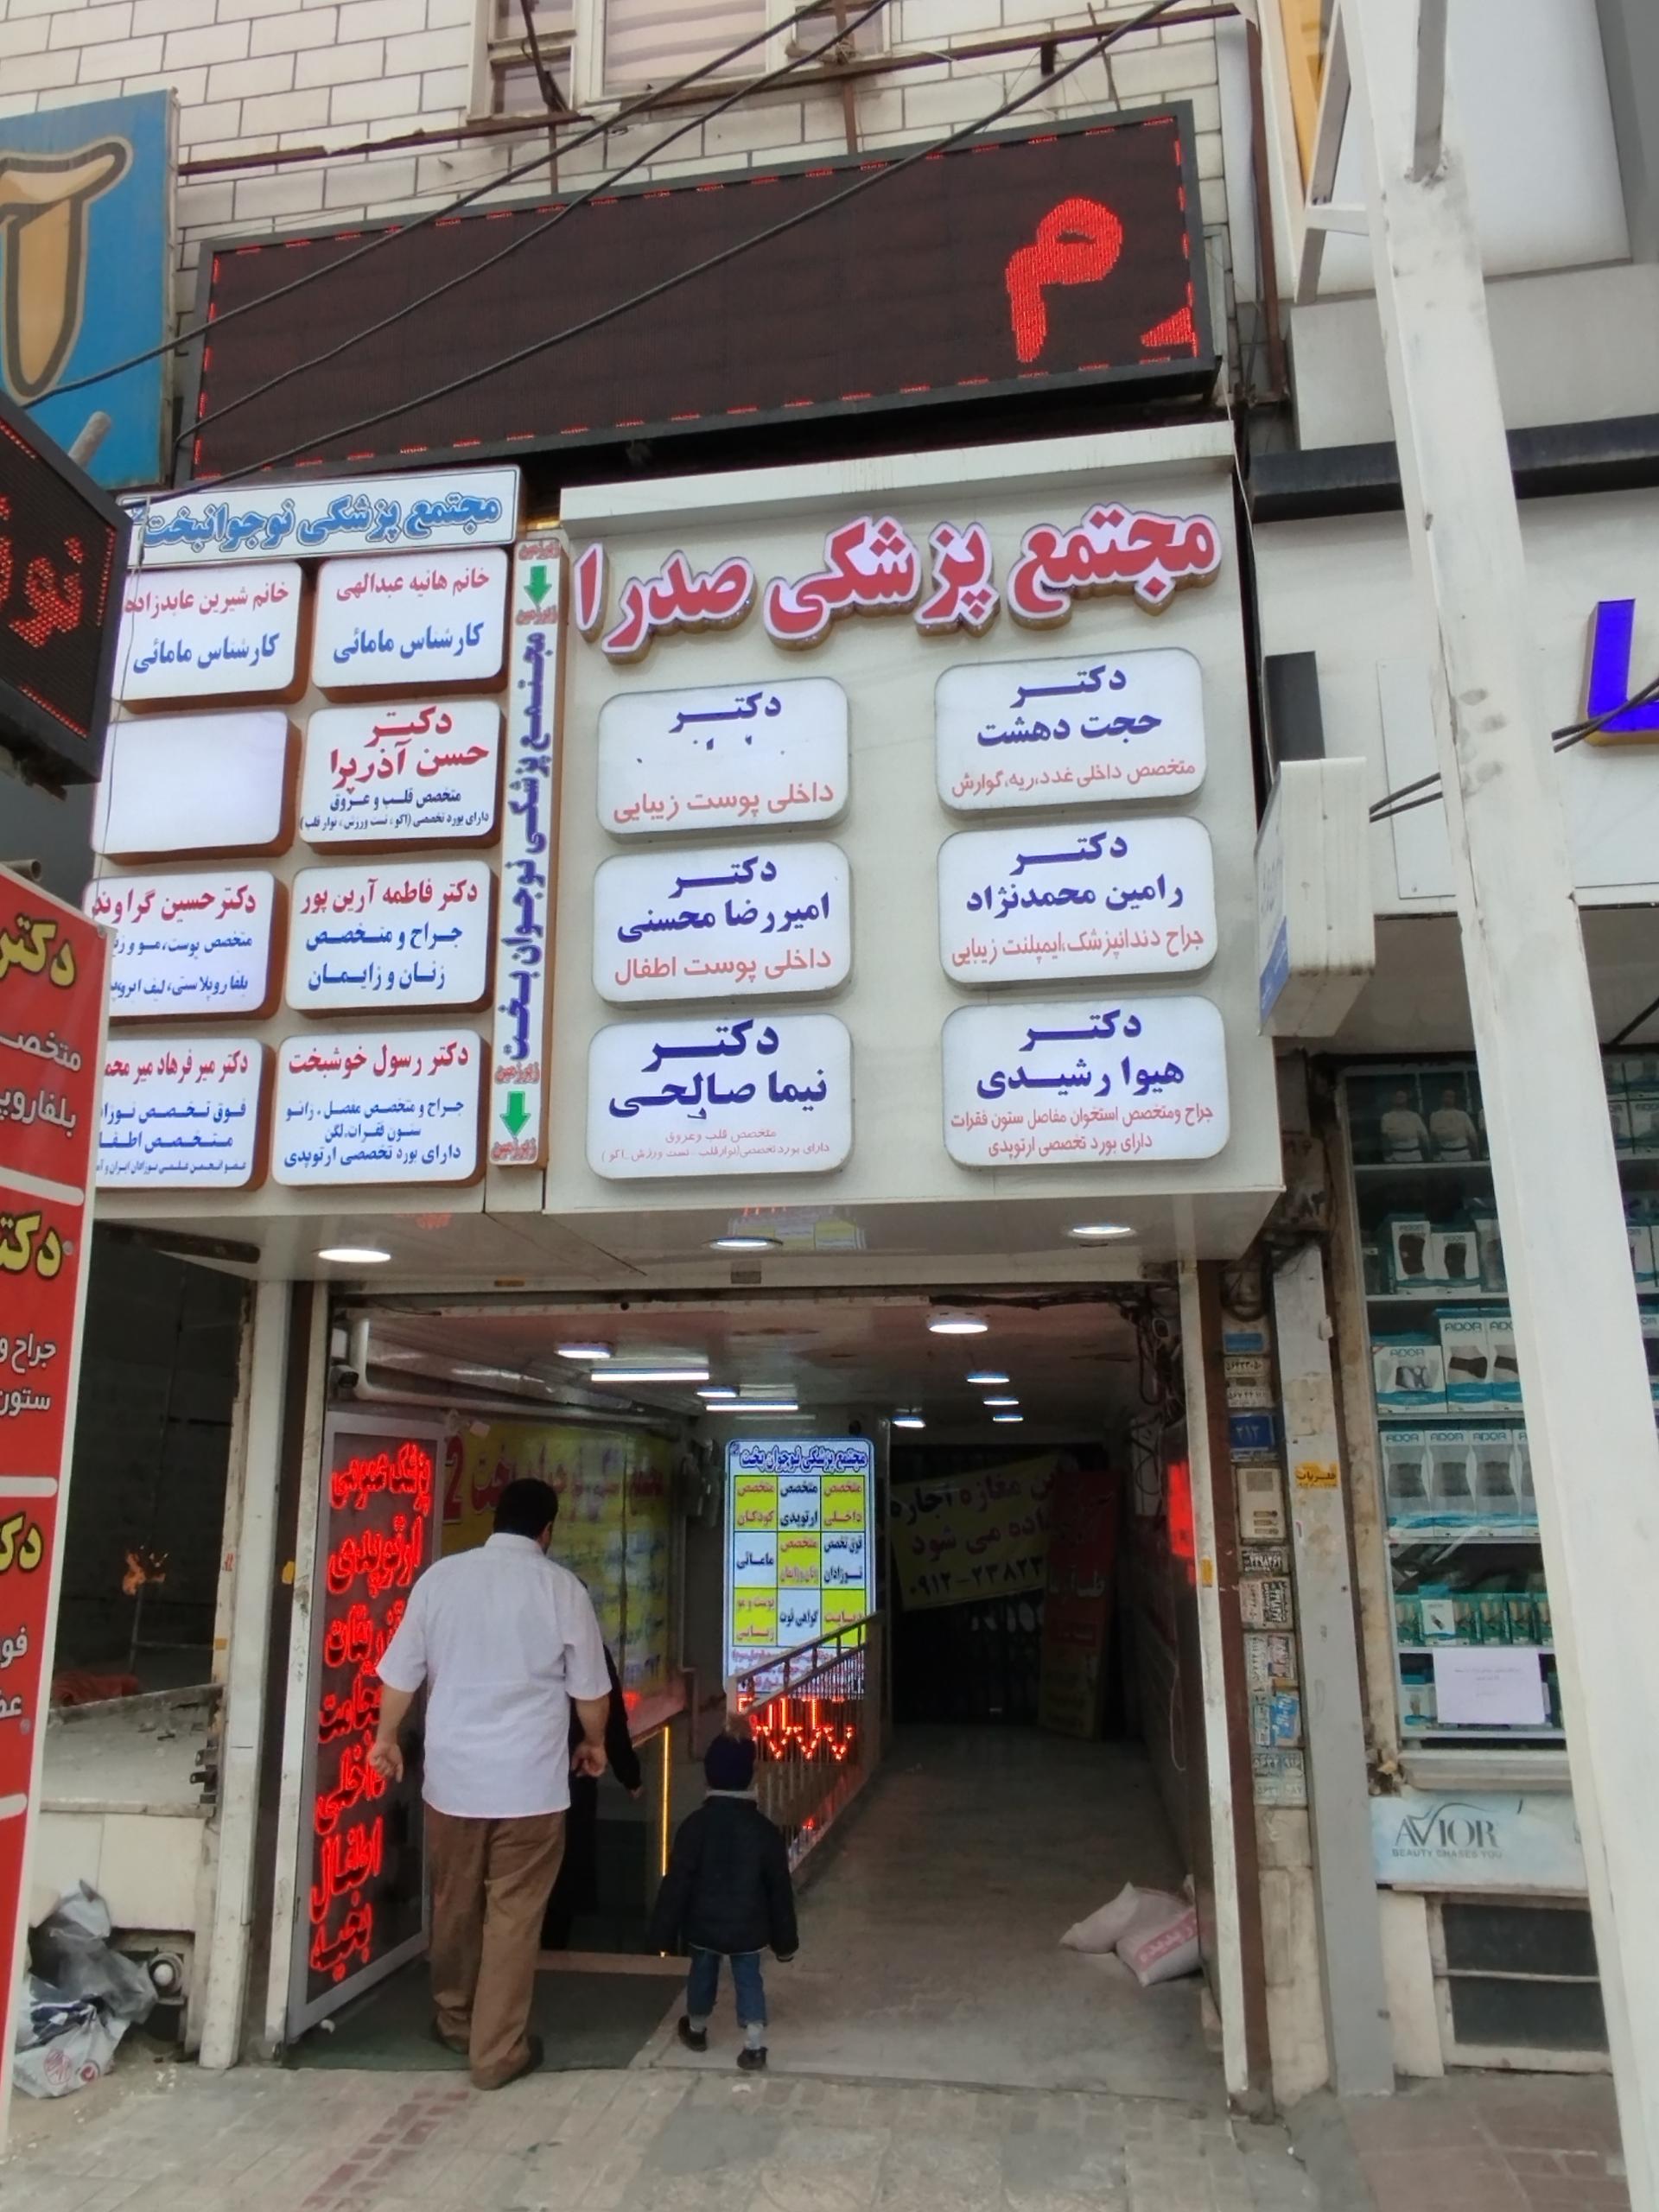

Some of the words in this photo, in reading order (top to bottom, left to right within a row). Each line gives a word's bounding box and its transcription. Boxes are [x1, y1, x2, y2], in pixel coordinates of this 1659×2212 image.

[296, 493, 402, 547] پزشکی
[404, 492, 502, 539] مجتمع
[1007, 501, 1222, 626] مجتمع
[336, 572, 404, 601] عبدالهی
[409, 569, 448, 597] هانیه
[453, 567, 490, 596] خانم
[764, 516, 999, 645] پزشکی
[124, 589, 194, 619] عابدزاده
[199, 587, 248, 615] شیرین
[252, 581, 289, 610] خانم
[575, 542, 755, 655] صدرا
[198, 632, 280, 669] کارشناس
[334, 627, 394, 664] مامائی
[400, 621, 484, 659] کارشناس
[133, 638, 192, 674] مامائی
[518, 631, 553, 752] مجتمع
[1009, 664, 1127, 709] دکتر
[364, 705, 453, 747] دکتر
[668, 691, 782, 734] دکتر
[976, 716, 1071, 747] دهشت
[1080, 714, 1162, 744] حجت
[416, 745, 489, 778] حسن
[1077, 764, 1122, 788] داخلی
[1127, 759, 1195, 785] متخصص
[330, 793, 370, 811] عروق
[373, 796, 379, 810] و
[382, 787, 414, 808] قلب
[416, 788, 461, 809] متخصص
[508, 753, 552, 855] پزشکی
[613, 792, 679, 823] زیبایی
[687, 791, 760, 817] پوست
[767, 782, 834, 814] داخلی
[413, 812, 444, 829] تخصصی
[447, 813, 464, 827] بورد
[467, 810, 489, 827] دارای
[1008, 831, 1128, 875] دکتر
[382, 877, 432, 905] فاطمه
[668, 855, 778, 899] دکتر
[215, 884, 257, 920] دکتر
[437, 879, 478, 912] دکتر
[966, 882, 1096, 918] محمدنژاد
[1104, 874, 1184, 911] رامین
[161, 892, 216, 923] حسین
[724, 892, 830, 933] امیررضا
[306, 922, 392, 952] متخصص
[396, 931, 406, 950] و
[410, 920, 463, 949] جراح
[617, 908, 715, 944] محسنی
[127, 943, 135, 956] و
[137, 942, 161, 956] مو
[204, 931, 253, 954] متخصص
[952, 938, 997, 967] زیبایی
[1003, 931, 1062, 964] ایمپلنت
[1166, 925, 1204, 957] جراح
[308, 961, 382, 991] زایمان
[398, 960, 446, 990] زنان
[614, 956, 677, 986] اطفال
[683, 958, 756, 983] پوست
[765, 947, 831, 980] داخلی
[385, 969, 395, 991] و
[1019, 1008, 1142, 1052] دکتر
[0, 1029, 82, 1073] متخص
[427, 1041, 469, 1076] دکتر
[641, 1019, 779, 1072] دکتر
[105, 1058, 130, 1078] محم
[133, 1061, 153, 1084] میر
[157, 1048, 193, 1084] فرهاد
[194, 1058, 215, 1084] میر
[218, 1050, 249, 1083] دکتر
[289, 1046, 367, 1079] خوشبخت
[372, 1044, 423, 1077] رسول
[768, 1068, 827, 1112] نیما
[976, 1058, 1111, 1099] رشیدی
[1121, 1055, 1185, 1096] هیوا
[364, 1099, 415, 1118] متخصص
[427, 1097, 464, 1117] جراح
[608, 1071, 756, 1118] صالحی
[138, 1100, 210, 1124] تخصص
[213, 1097, 246, 1123] فوق
[418, 1104, 424, 1117] و
[950, 1110, 988, 1132] فقرات
[991, 1112, 1024, 1132] ستون
[1027, 1109, 1066, 1130] مفاصل
[1071, 1106, 1118, 1129] استخوان
[1184, 1103, 1213, 1127] جراح
[99, 1130, 142, 1148] اطفا
[144, 1130, 233, 1154] متخصص
[387, 1122, 421, 1141] ستون
[706, 1129, 727, 1141] قلب
[731, 1128, 777, 1142] متخصص
[1038, 1134, 1086, 1157] تخصصی
[1121, 1131, 1153, 1154] دارای
[283, 1145, 337, 1168] ارتوپدی
[340, 1144, 392, 1166] تخصصی
[396, 1146, 418, 1165] بورد
[421, 1143, 461, 1165] دارای
[988, 1136, 1035, 1159] ارتوپدی
[1090, 1137, 1116, 1156] بورد
[0, 1211, 64, 1281] دکت
[1444, 1321, 1482, 1332] ADOR
[11, 1331, 57, 1374] جراح
[1389, 1348, 1425, 1357] ADOR
[1385, 1433, 1420, 1442] ADOR
[1430, 1432, 1464, 1441] ADOR
[1472, 1431, 1508, 1441] ADOR
[835, 1447, 868, 1472] مجتمع
[738, 1480, 774, 1497] متخصص
[780, 1480, 818, 1497] متخصص
[823, 1480, 861, 1496] متخصص
[780, 1510, 817, 1528] ارتوپدی
[328, 1513, 424, 1593] ارتوپدی
[1395, 1814, 1499, 1847] AVIOR
[1391, 1848, 1433, 1858] BEAUTY
[1481, 1849, 1503, 1859] YOU
